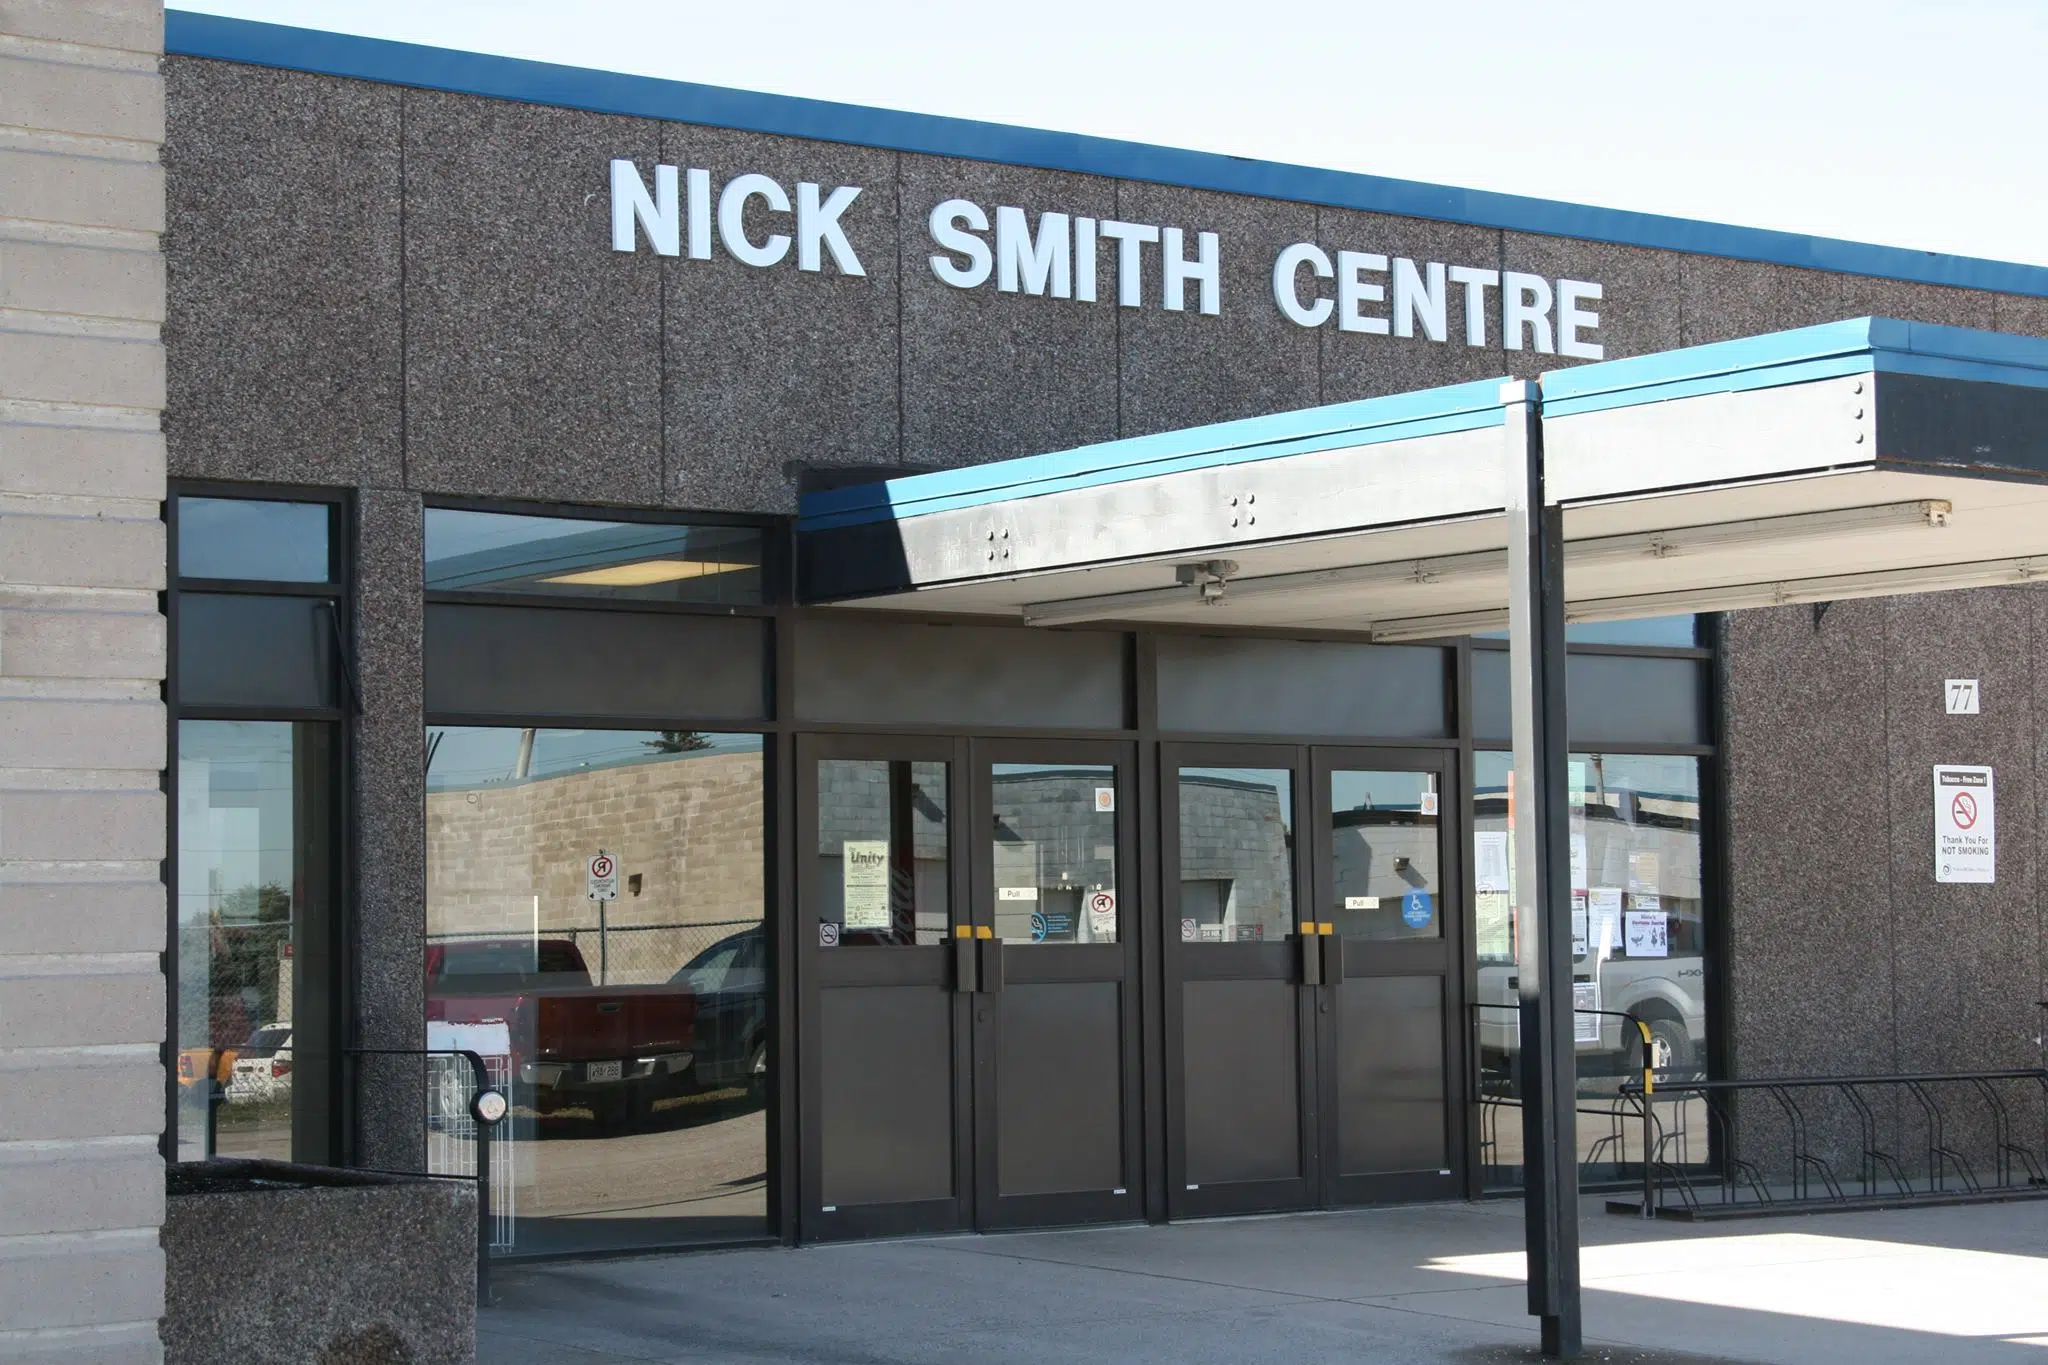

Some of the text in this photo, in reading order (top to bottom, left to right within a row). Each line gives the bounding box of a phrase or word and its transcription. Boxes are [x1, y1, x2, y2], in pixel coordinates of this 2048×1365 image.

[610, 158, 1604, 360] NICK SMITH CENTRE
[1951, 684, 1973, 710] 77
[1942, 835, 1989, 844] Thank You For
[1941, 846, 1989, 855] NOT SMOKING
[850, 851, 884, 866] Unity
